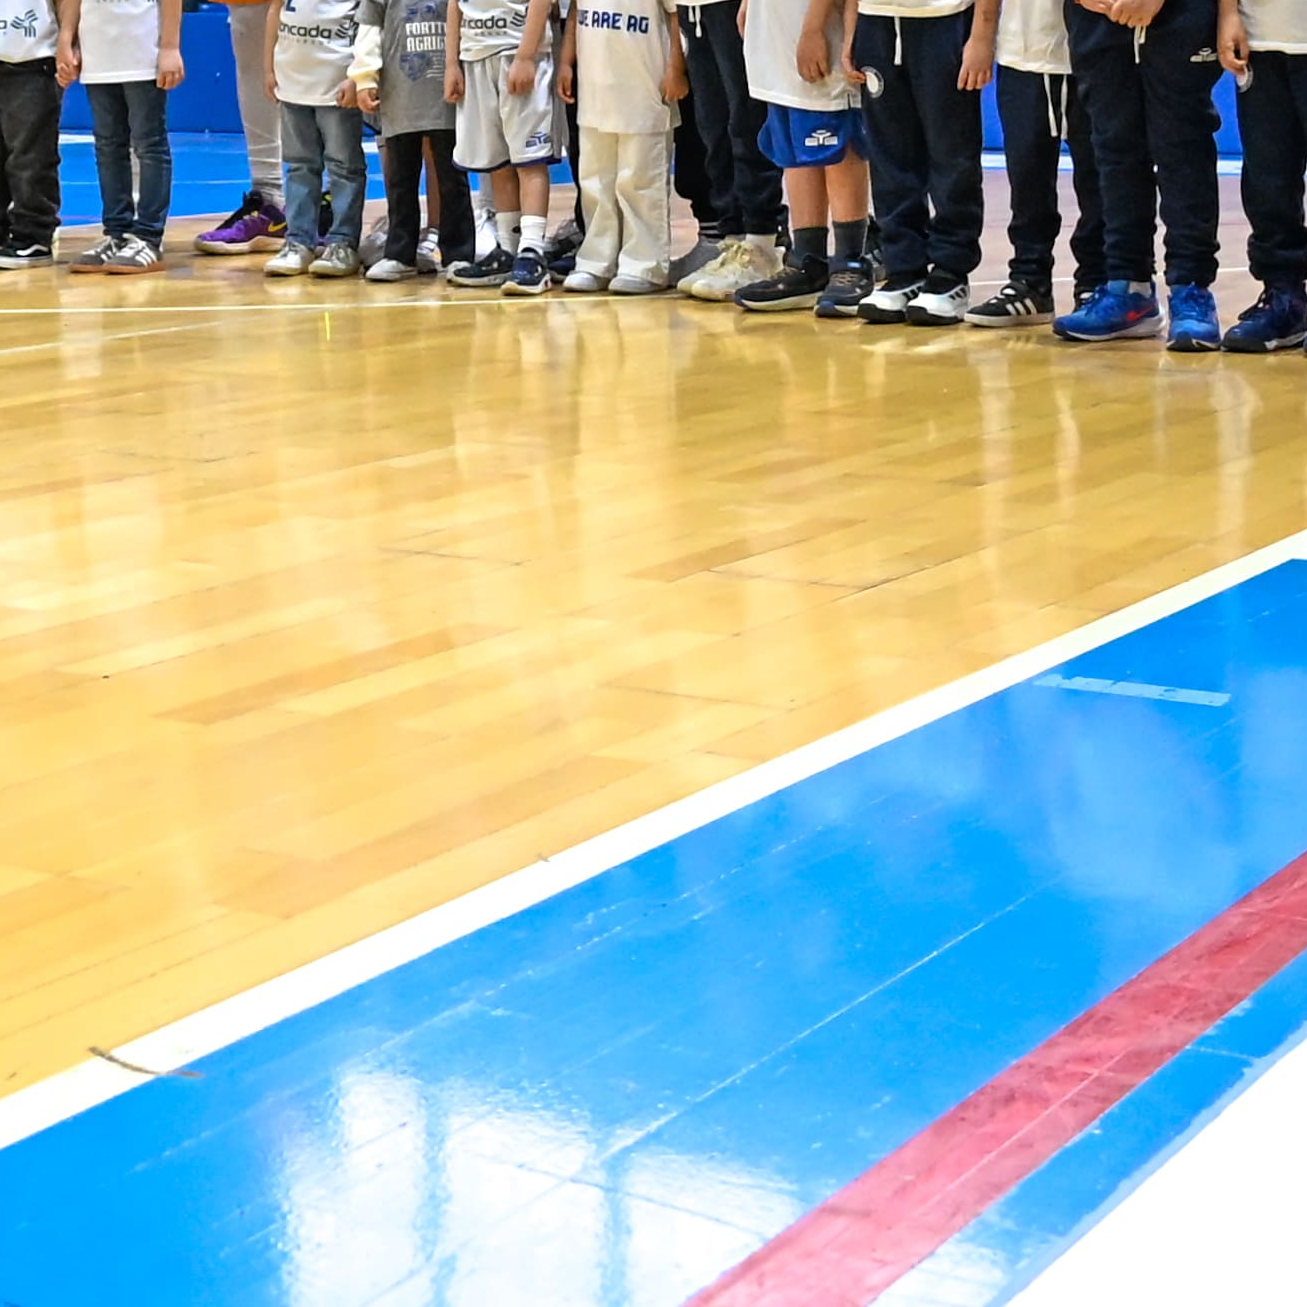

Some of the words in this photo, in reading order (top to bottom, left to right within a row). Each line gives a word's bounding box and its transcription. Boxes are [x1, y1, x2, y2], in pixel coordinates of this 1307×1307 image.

[591, 10, 623, 30] ARE
[626, 15, 650, 34] AG
[279, 23, 332, 39] oncada
[406, 36, 446, 52] AGRIG
